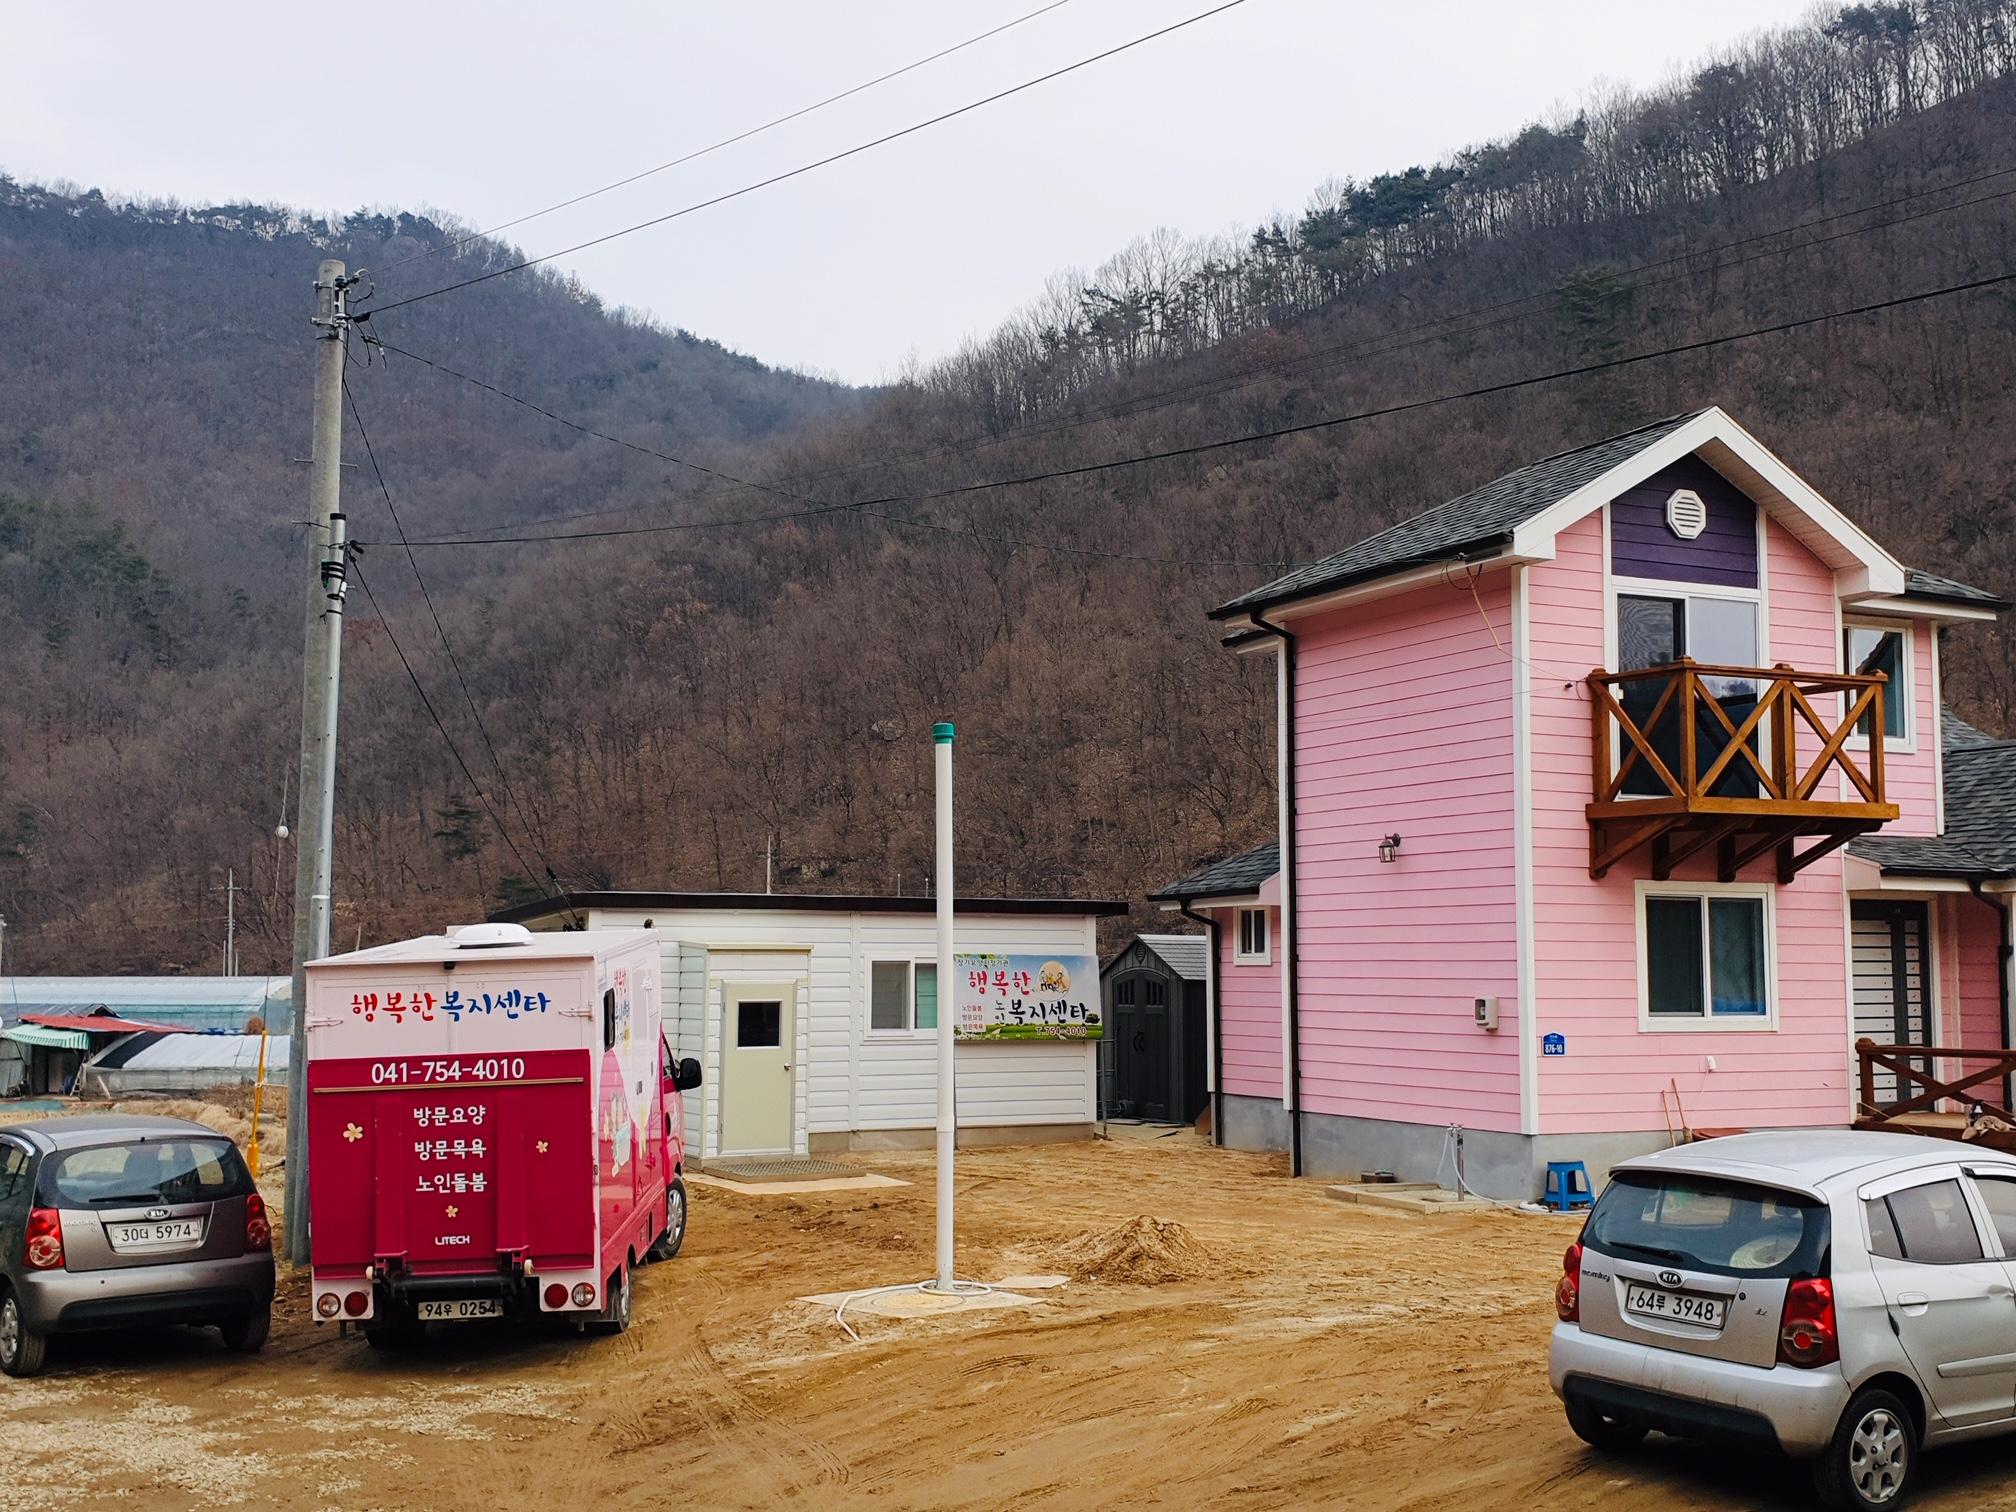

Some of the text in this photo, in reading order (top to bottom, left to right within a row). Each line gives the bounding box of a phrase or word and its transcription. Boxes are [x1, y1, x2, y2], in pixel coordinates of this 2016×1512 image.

[967, 970, 1032, 996] 행복한
[371, 1057, 526, 1084] 041-754-4010
[413, 1105, 487, 1127] 방문요양
[414, 1139, 487, 1160] 방문목욕
[415, 1173, 488, 1194] 노인돌봄
[150, 1209, 166, 1217] KIA
[121, 1224, 192, 1242] 30더 5974
[434, 1235, 471, 1245] LITECH
[1662, 1273, 1680, 1284] KIA
[425, 1301, 497, 1318] 94우 0254
[1636, 1290, 1715, 1321] 64루 3948
